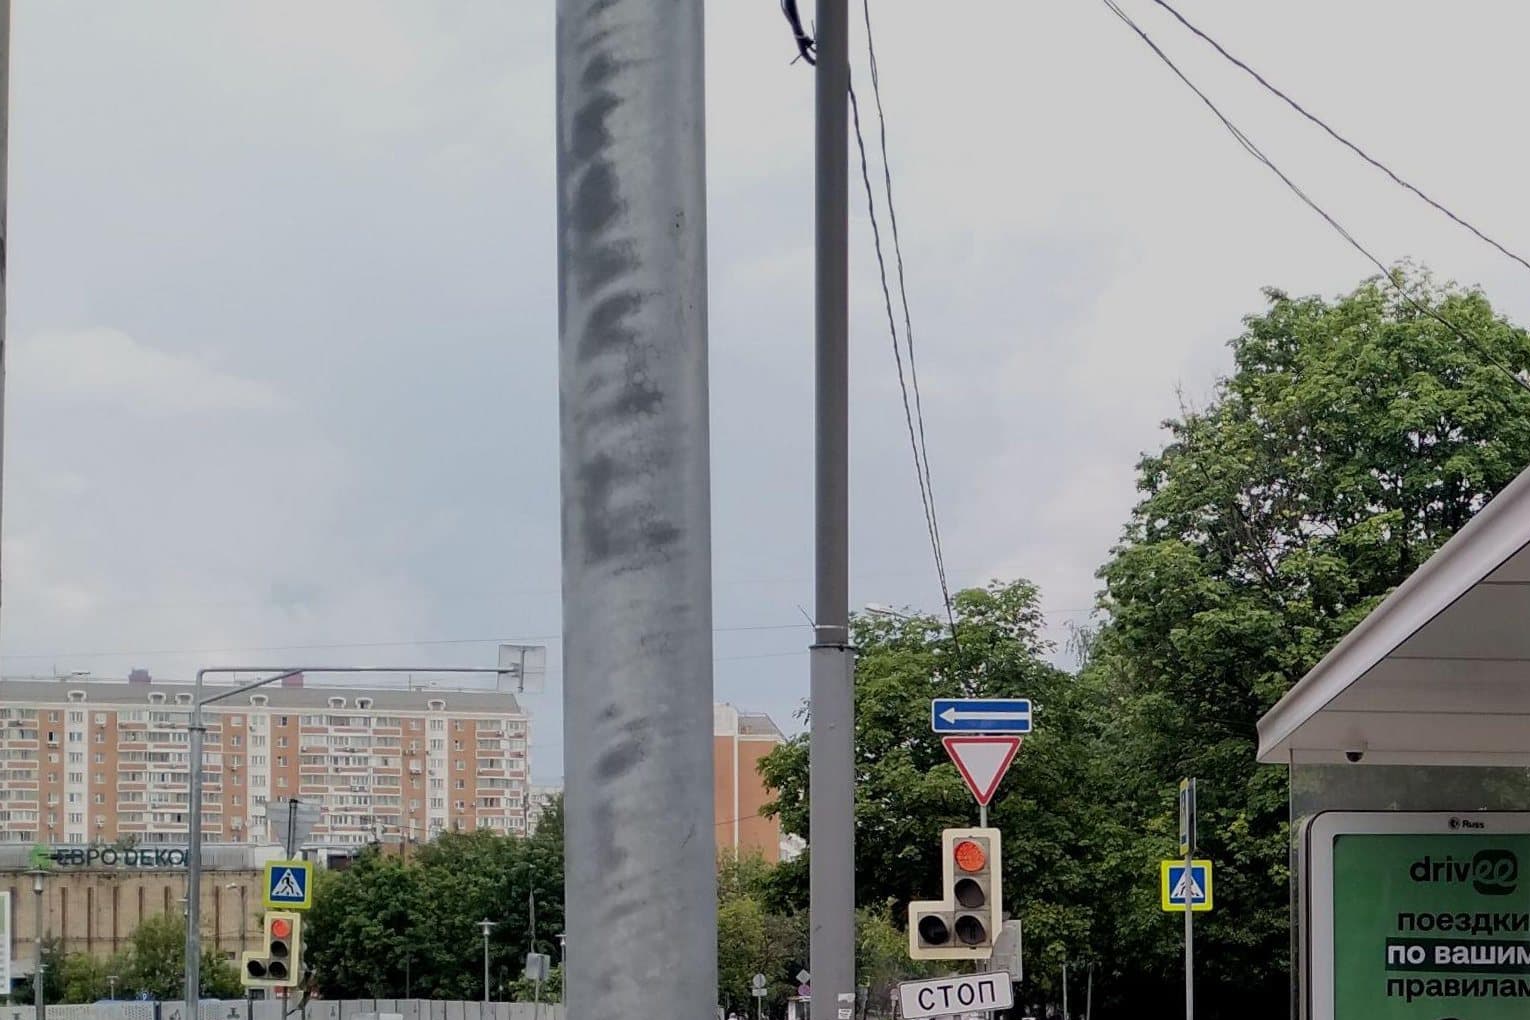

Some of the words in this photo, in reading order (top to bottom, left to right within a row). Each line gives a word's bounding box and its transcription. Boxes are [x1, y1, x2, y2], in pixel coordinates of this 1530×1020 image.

[123, 848, 188, 867] DEKO
[1397, 912, 1530, 936] поездки
[1387, 945, 1427, 965] по
[918, 980, 996, 1010] СТОП
